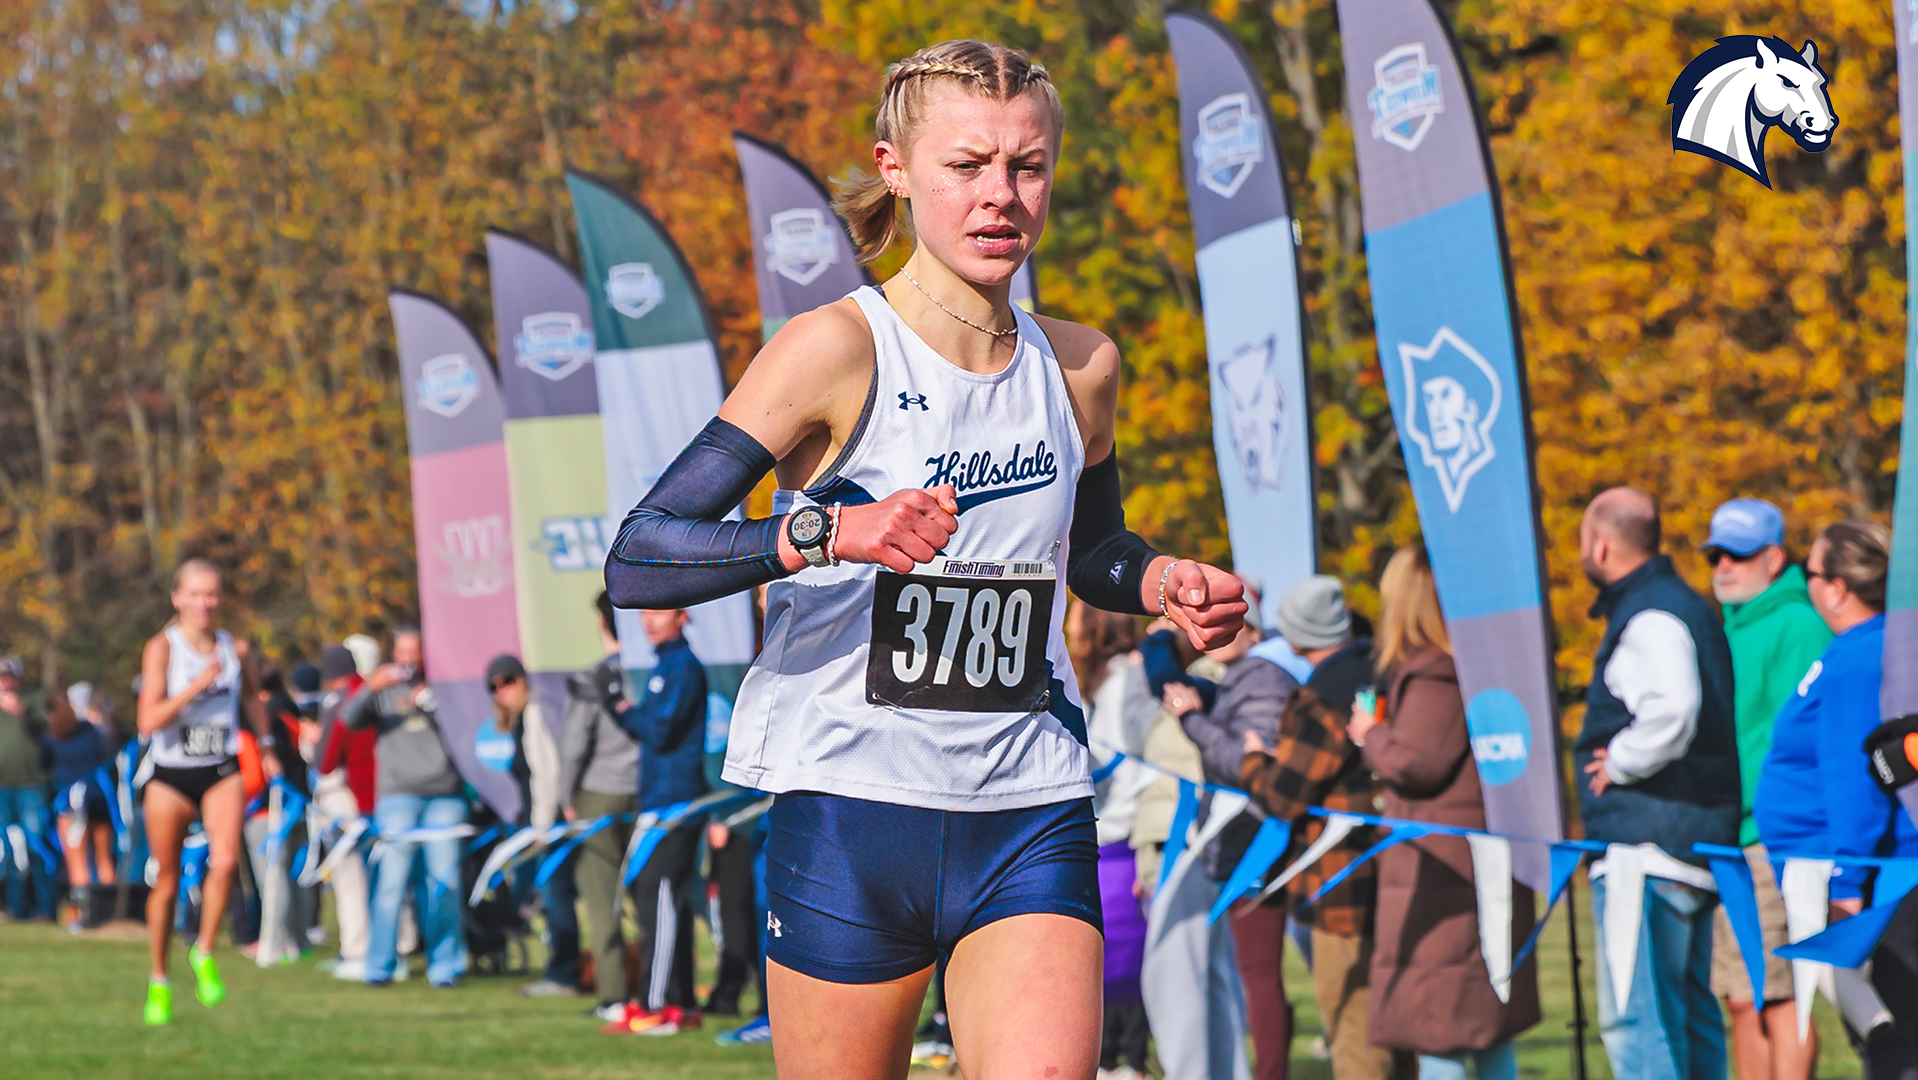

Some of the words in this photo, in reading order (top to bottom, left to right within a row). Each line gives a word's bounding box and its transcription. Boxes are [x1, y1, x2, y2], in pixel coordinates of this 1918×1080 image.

[924, 440, 1057, 492] Hillsdale
[794, 518, 821, 531] 20:30
[943, 560, 1005, 577] FinishTiming
[892, 583, 1032, 688] 3789
